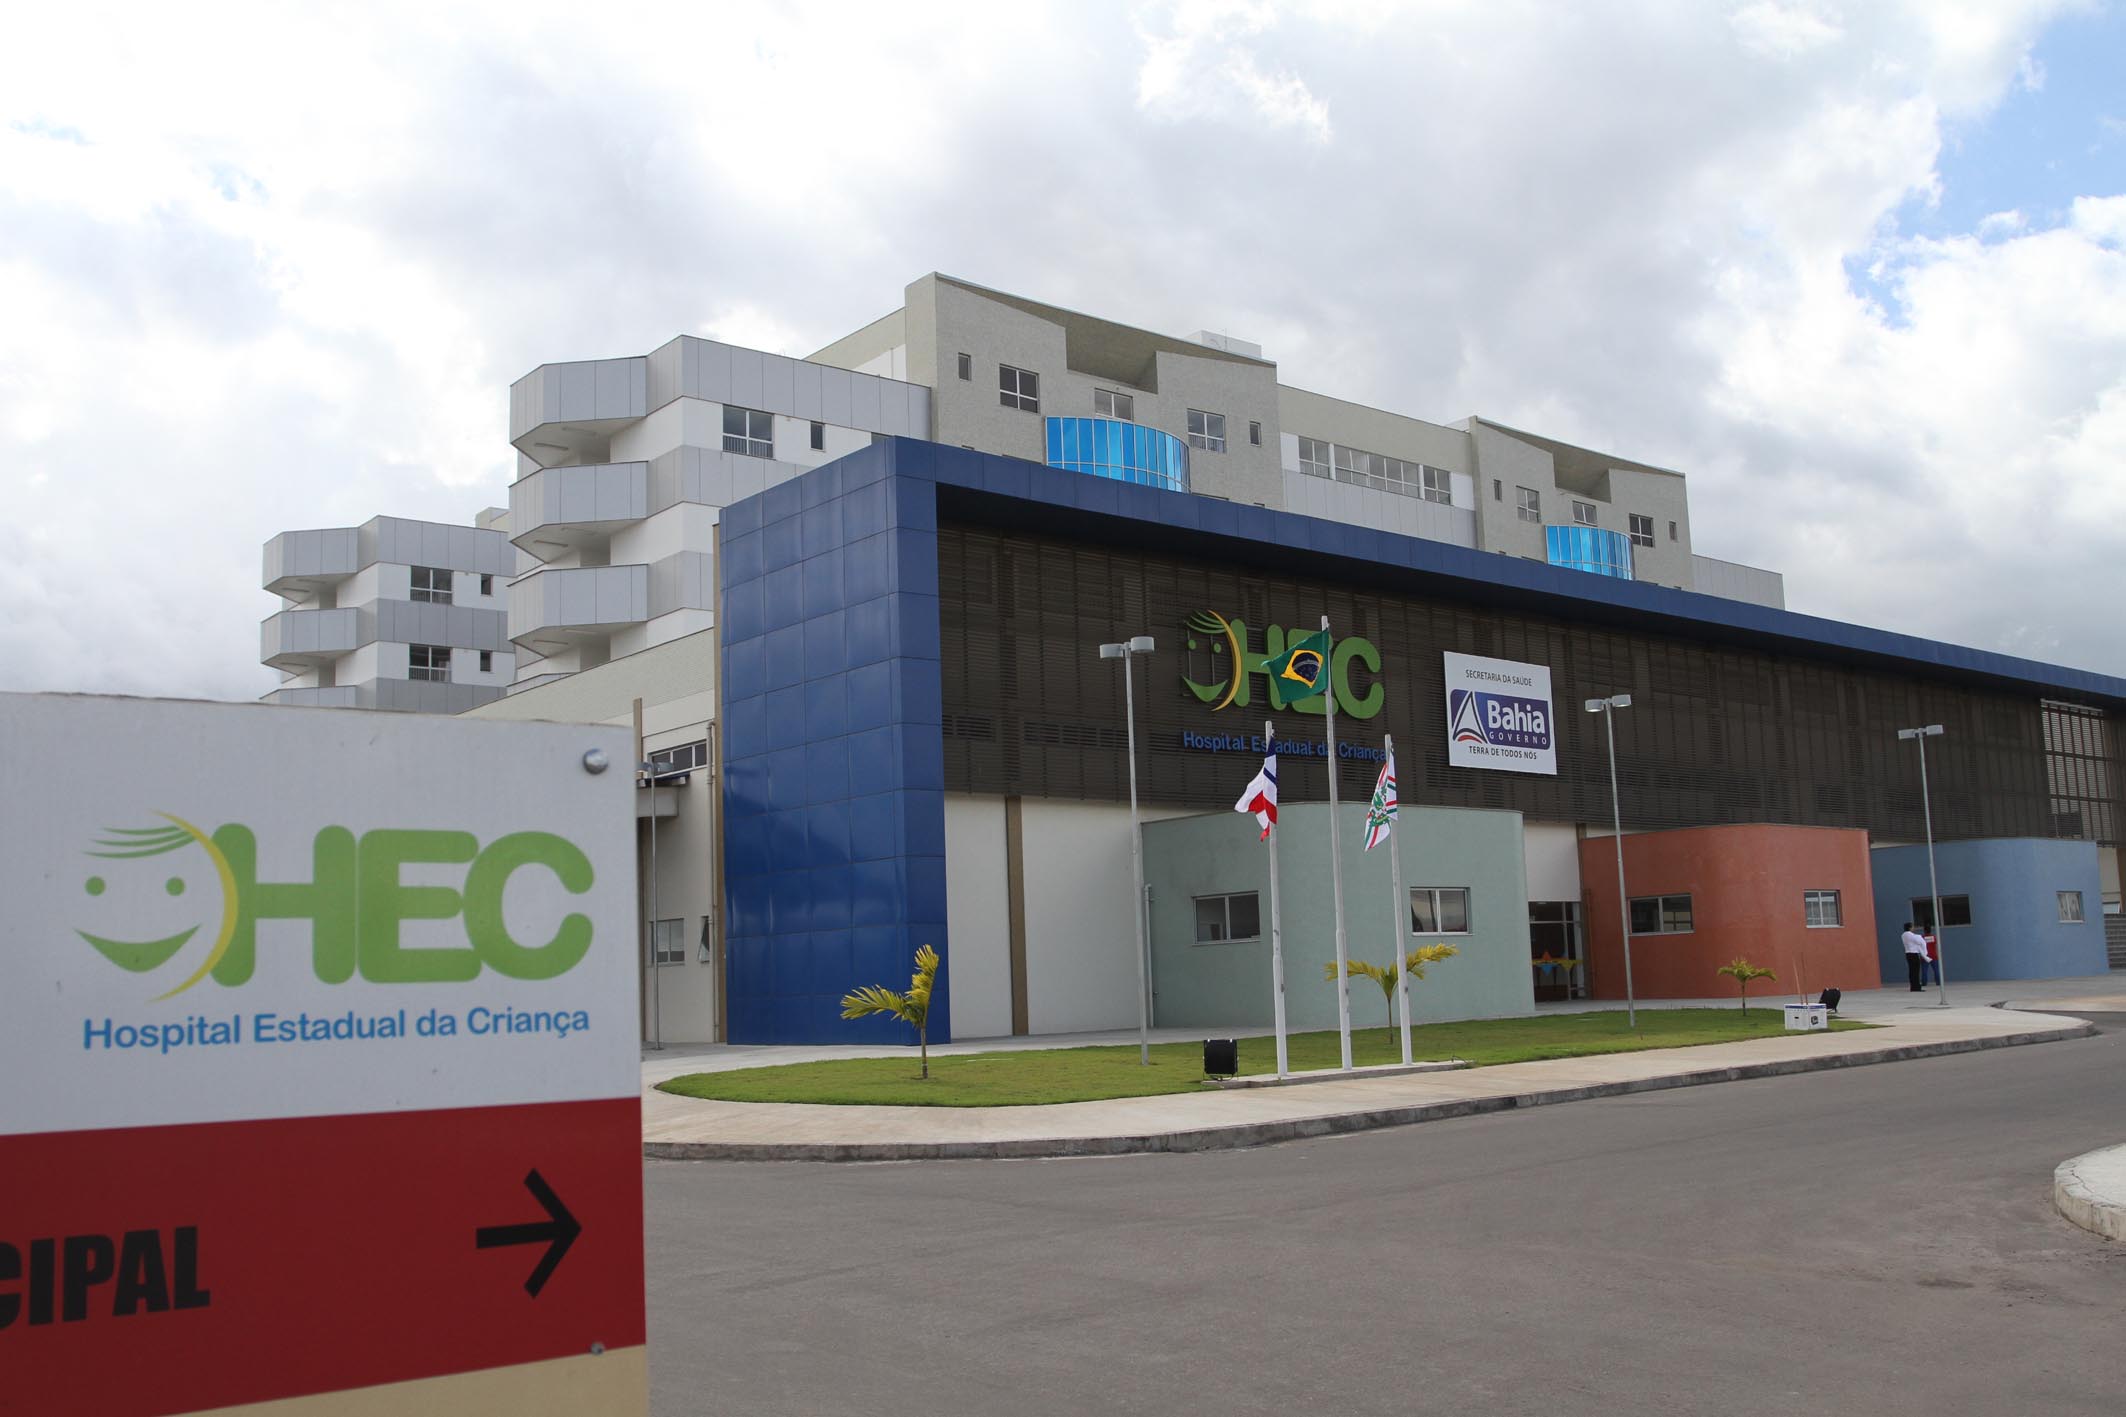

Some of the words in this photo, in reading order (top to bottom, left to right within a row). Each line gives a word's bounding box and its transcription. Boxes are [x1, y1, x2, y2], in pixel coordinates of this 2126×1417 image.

[1465, 669, 1502, 683] SECRETARIA
[1502, 674, 1512, 684] DA
[1512, 676, 1532, 686] SAÚDE
[1487, 700, 1545, 734] Bahia
[1183, 731, 1246, 752] Hospital
[1251, 736, 1312, 756] Esadual
[1339, 742, 1387, 762] Criança
[1469, 746, 1489, 756] TERRA
[1501, 749, 1522, 759] TODOS
[1489, 731, 1547, 745] GOVERNO
[210, 823, 595, 988] HEC
[83, 1014, 241, 1054] Hospital
[253, 1009, 405, 1043] Estadual
[415, 1008, 457, 1037] da
[467, 1006, 590, 1039] Criança
